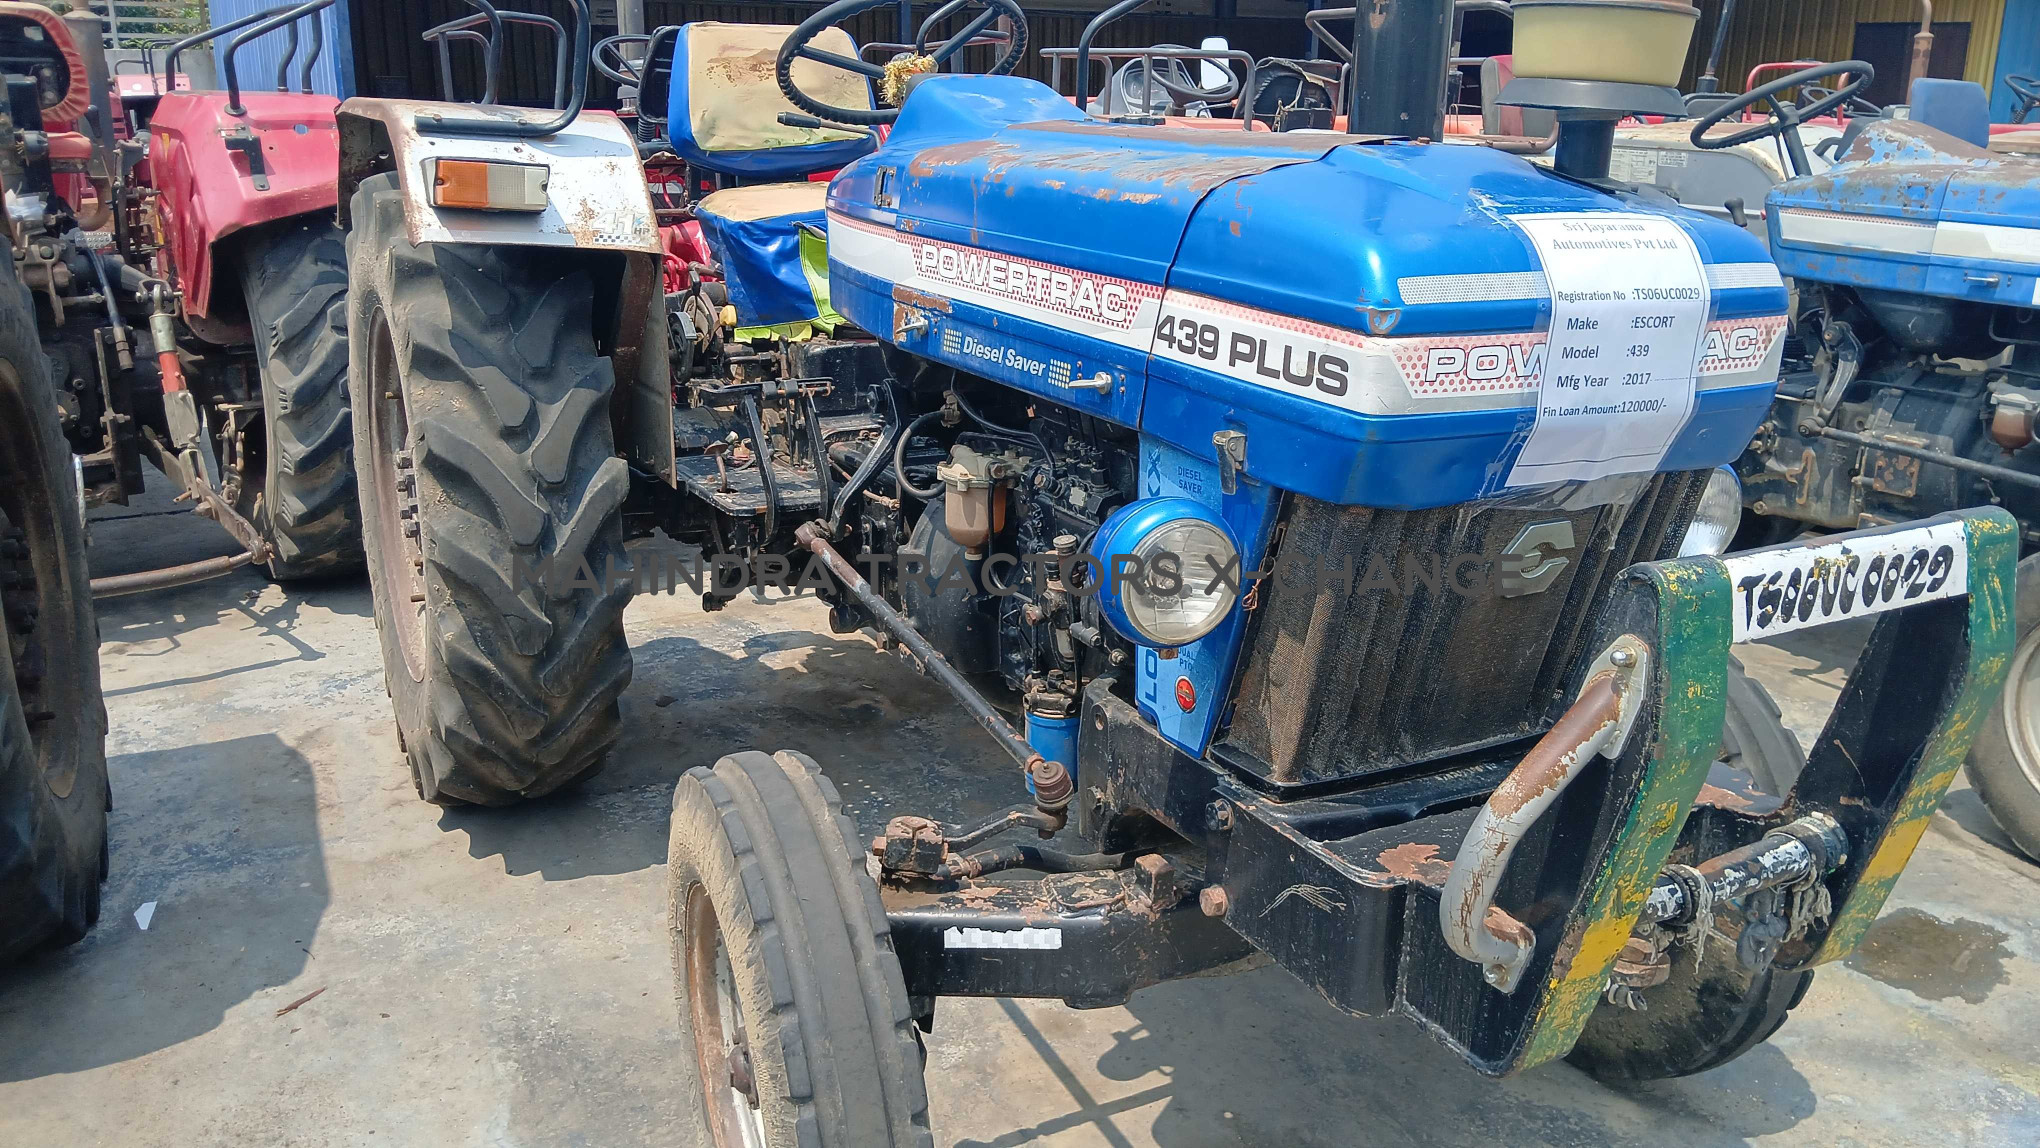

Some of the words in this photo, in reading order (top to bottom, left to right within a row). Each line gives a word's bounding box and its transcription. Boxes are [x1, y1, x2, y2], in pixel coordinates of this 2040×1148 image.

[1563, 221, 1583, 232] Sri
[1587, 222, 1645, 234] Jayarama
[1553, 238, 1633, 250] Automotives
[1636, 238, 1656, 250] Pvt
[1657, 238, 1679, 250] Ltd
[921, 243, 1128, 323] POWERTRAC
[1557, 290, 1611, 304] Registration
[1613, 290, 1626, 301] No
[1567, 317, 1598, 331] Make
[963, 336, 1004, 364] Diesel
[1005, 348, 1047, 377] Saver
[1156, 314, 1220, 361] 439
[1228, 331, 1349, 397] PLUS
[1561, 346, 1599, 360] Model
[1556, 374, 1581, 391] Mfg
[1584, 374, 1609, 388] Year
[1543, 406, 1556, 418] Fin
[1559, 405, 1580, 417] Loan
[1177, 465, 1204, 483] DIESEL
[1178, 479, 1203, 495] SAVER
[1179, 657, 1194, 672] PTO
